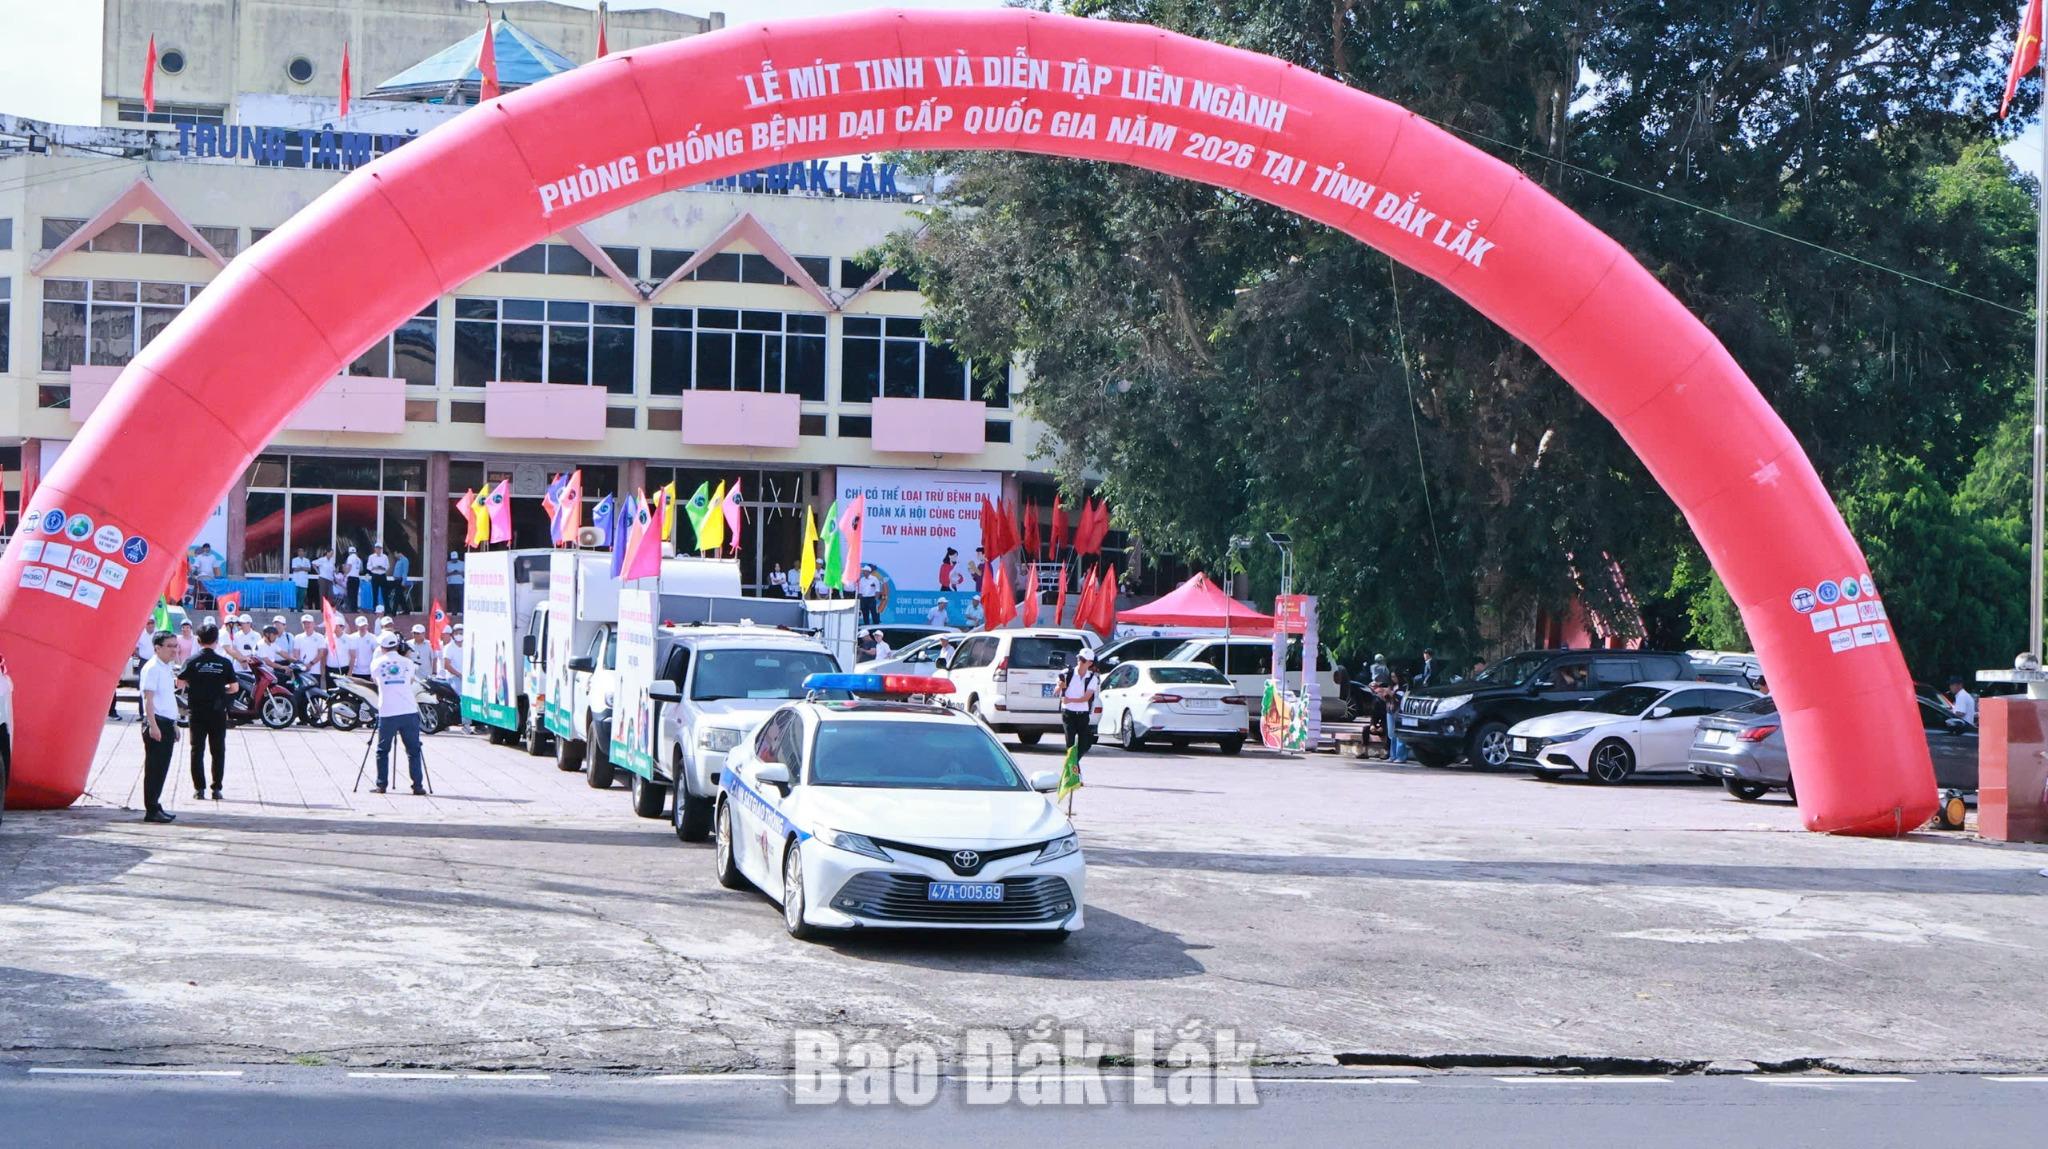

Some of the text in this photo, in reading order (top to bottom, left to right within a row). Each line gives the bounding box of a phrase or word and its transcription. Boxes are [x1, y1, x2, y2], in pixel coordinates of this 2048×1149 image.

[744, 46, 1288, 133] LỄ MÍT TINH VÀ DIỄN TẬP LIÊN NGÀNH
[175, 121, 286, 161] TRUNG
[300, 122, 372, 166] TÂM
[538, 96, 1496, 267] PHÒNG CHỐNG BỆNH DẠI CẤP QUỐC GIA NĂM 2026 TẠI TỈNH ĐẮK LẮK
[865, 487, 878, 500] CÓ
[882, 486, 900, 501] THỂ
[901, 491, 922, 504] LOẠI
[926, 489, 944, 502] TRỪ
[947, 489, 972, 504] BỆNH
[867, 504, 891, 518] TOÀN
[894, 504, 907, 518] XÃ
[910, 506, 927, 520] HỘI
[929, 505, 955, 519] CÙNG
[882, 525, 897, 536] TAY
[900, 522, 927, 537] HÀNH
